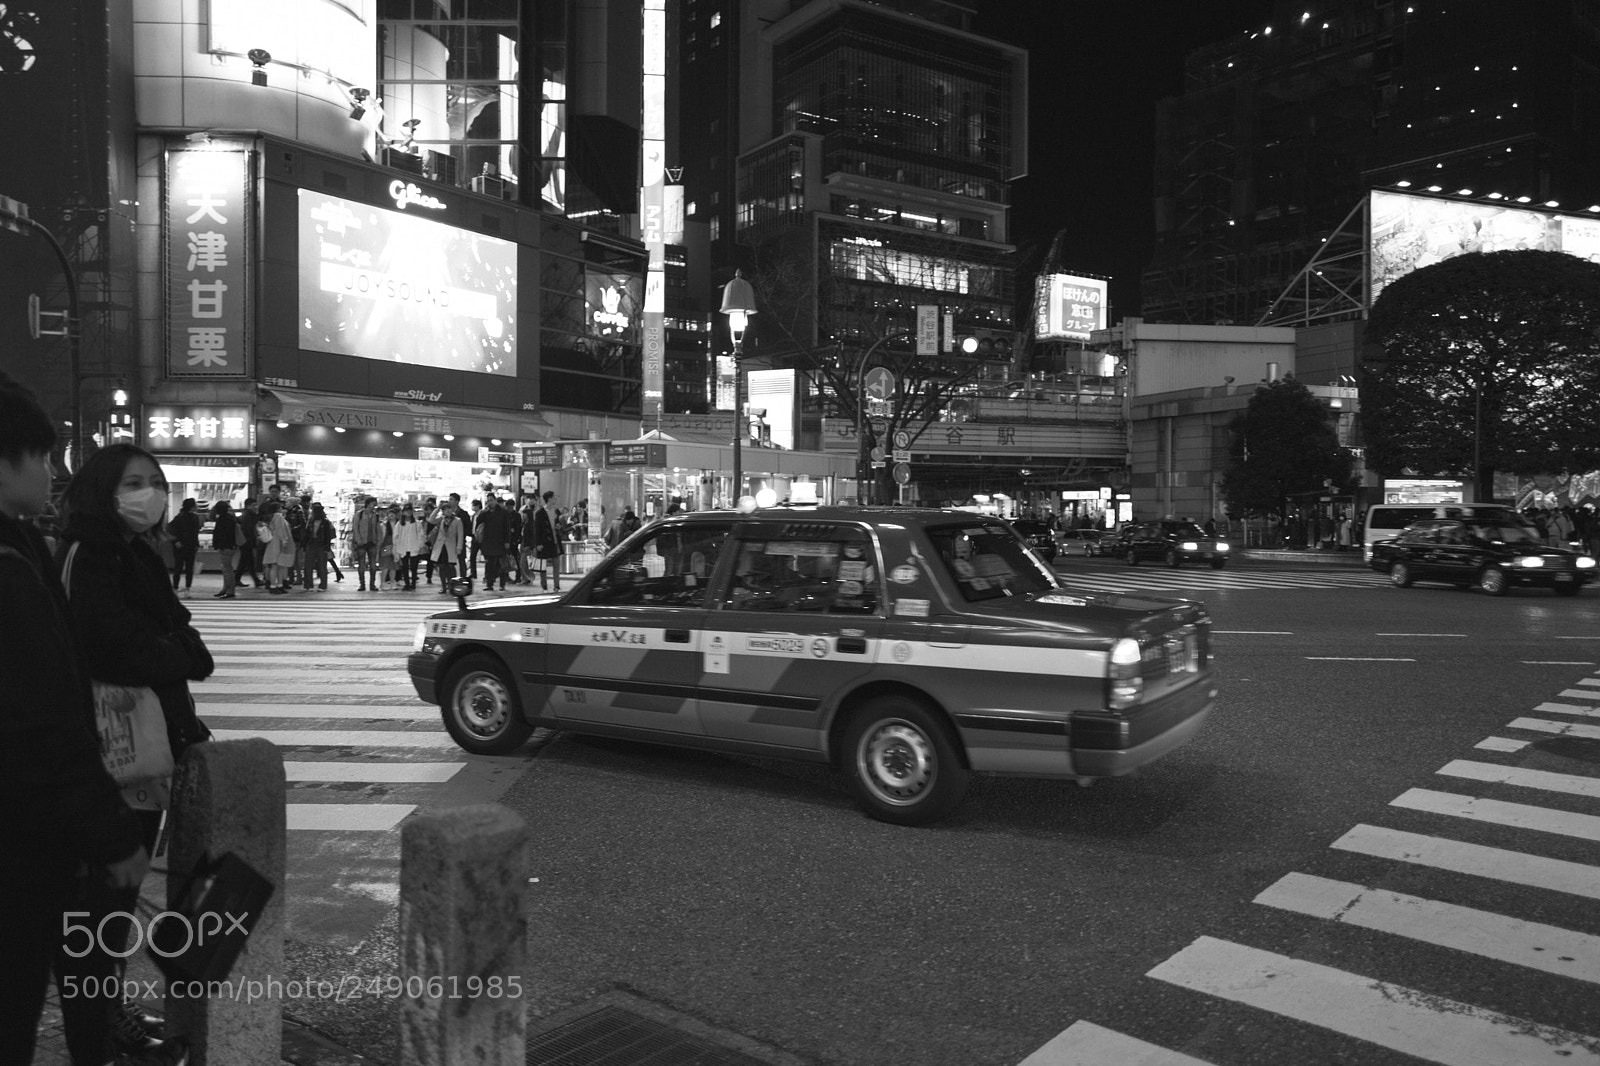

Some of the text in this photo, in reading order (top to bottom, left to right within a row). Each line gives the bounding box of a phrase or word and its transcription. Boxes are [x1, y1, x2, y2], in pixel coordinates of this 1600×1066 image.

[389, 179, 447, 210] Glico
[646, 205, 662, 243] アコム
[186, 186, 228, 367] 天津甘栗
[345, 274, 449, 308] JOYSOUND
[1063, 286, 1100, 304] ほけんの
[1071, 303, 1094, 319] 窓口
[1066, 319, 1096, 332] グループ
[648, 327, 659, 376] PROMISE
[148, 416, 245, 439] 天津甘栗
[306, 410, 378, 428] SANZENRI
